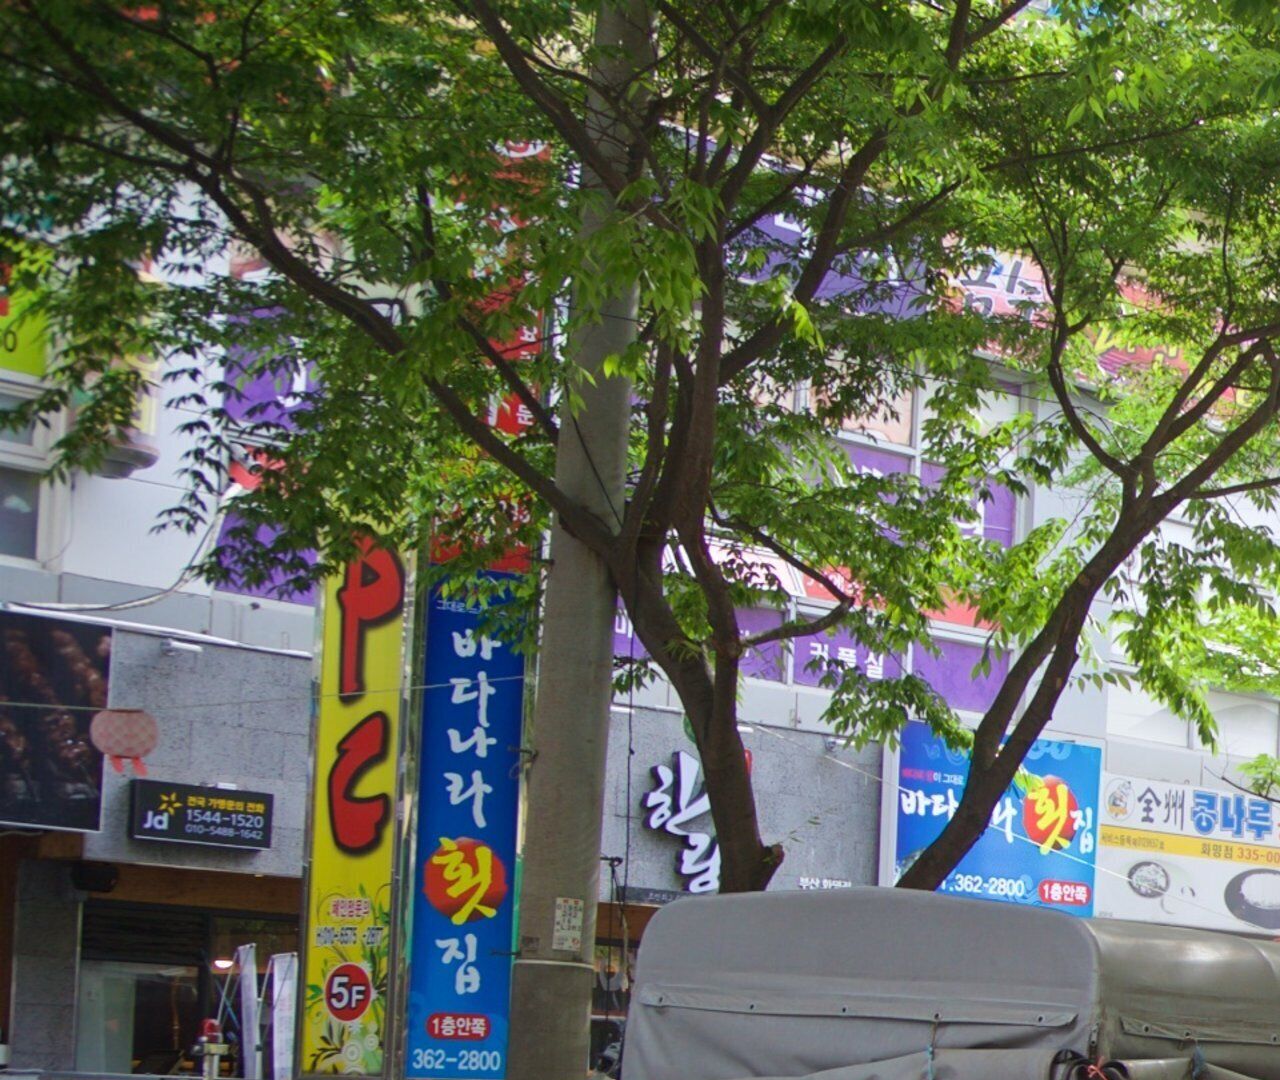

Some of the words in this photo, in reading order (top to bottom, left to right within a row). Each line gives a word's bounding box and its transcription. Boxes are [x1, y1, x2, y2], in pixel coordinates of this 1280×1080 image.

[443, 628, 503, 830] 바다나라
[187, 809, 264, 829] 1544-1520
[1190, 789, 1275, 841] 콩나루
[1200, 842, 1234, 860] 화명점
[1043, 882, 1089, 903] 1층안쪽
[431, 836, 498, 996] 횟집
[330, 976, 366, 1009] 5F
[431, 1015, 487, 1038] 1층안쪽
[412, 1048, 501, 1071] 362-2800
